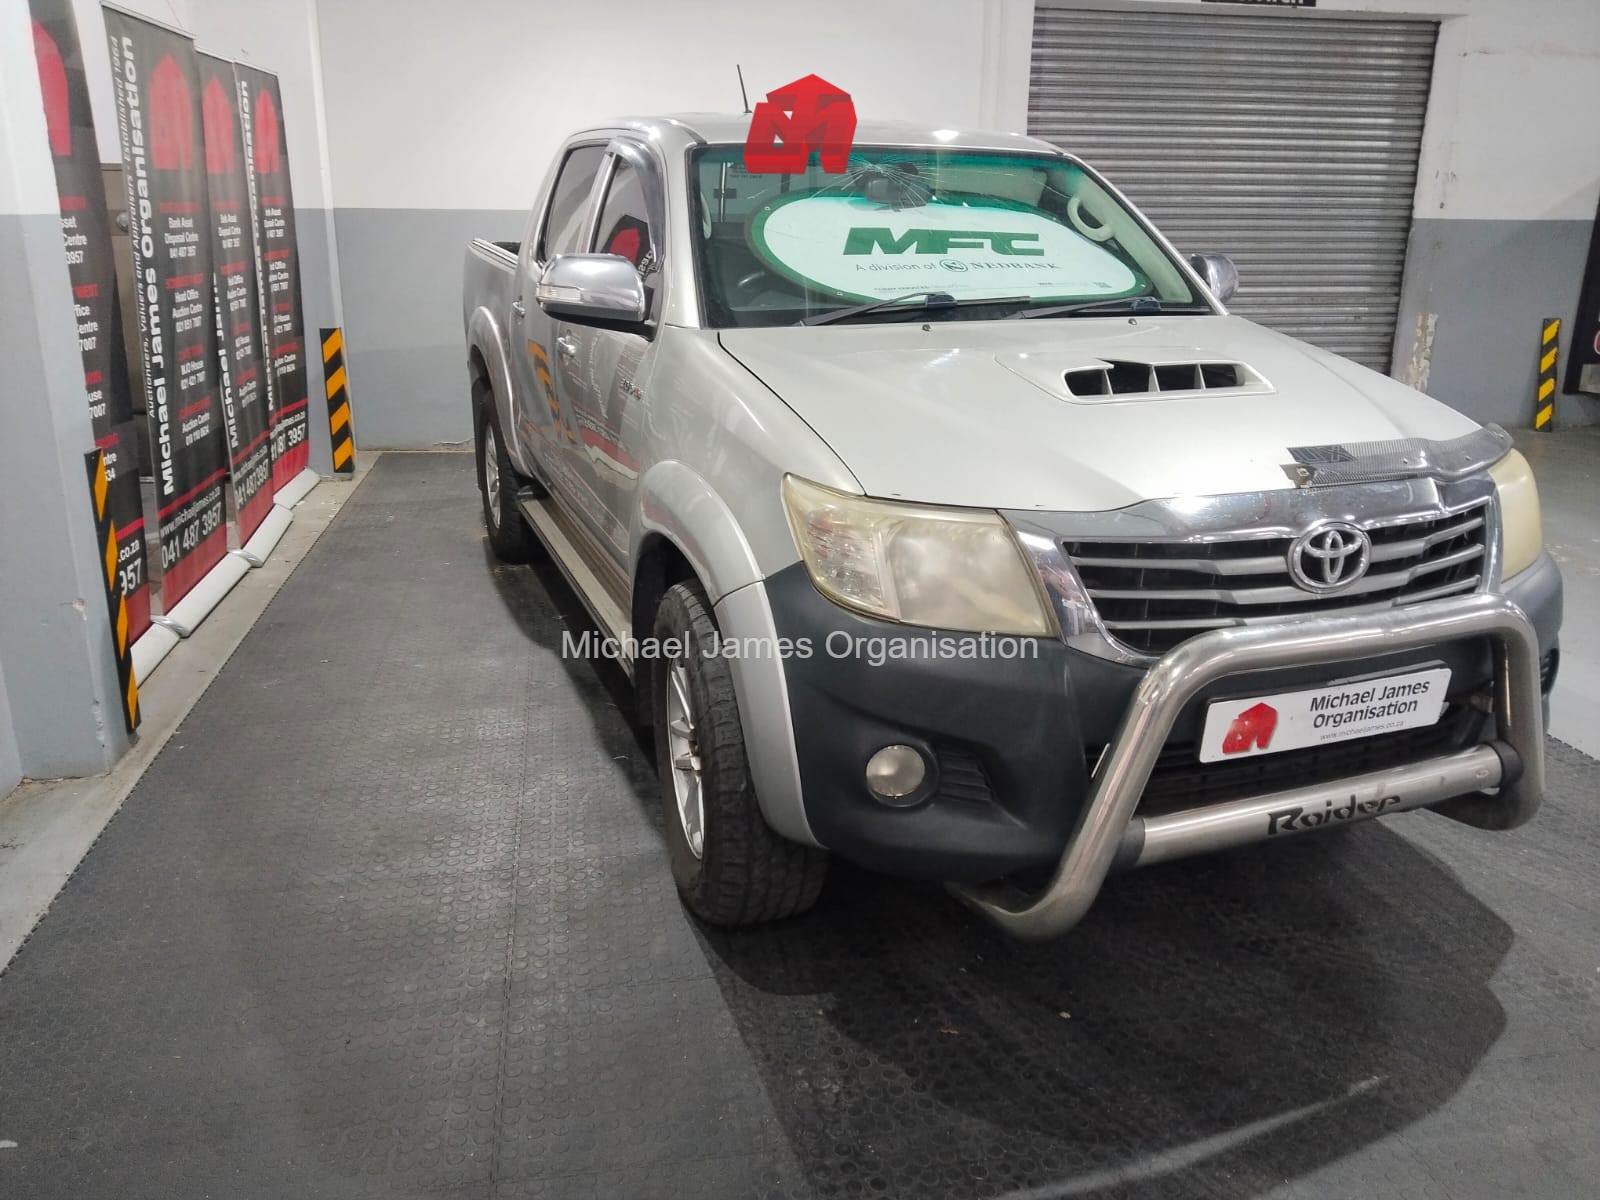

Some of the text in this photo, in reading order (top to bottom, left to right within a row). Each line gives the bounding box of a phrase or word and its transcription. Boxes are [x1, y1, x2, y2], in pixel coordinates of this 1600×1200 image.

[843, 227, 1044, 256] MFC
[122, 36, 174, 496] Michael James Organisation
[133, 251, 144, 279] and
[855, 263, 866, 271] A
[869, 262, 920, 272] division
[923, 261, 937, 270] of
[137, 282, 148, 332] Valuers
[218, 348, 239, 449] Michael
[287, 422, 306, 447] 3957
[161, 501, 222, 569] 041 487 3957
[1309, 681, 1431, 712] Michael James
[1313, 698, 1418, 729] Organisation
[1320, 720, 1405, 740] www.michaeljames.co.za
[1267, 794, 1401, 836] Raider
